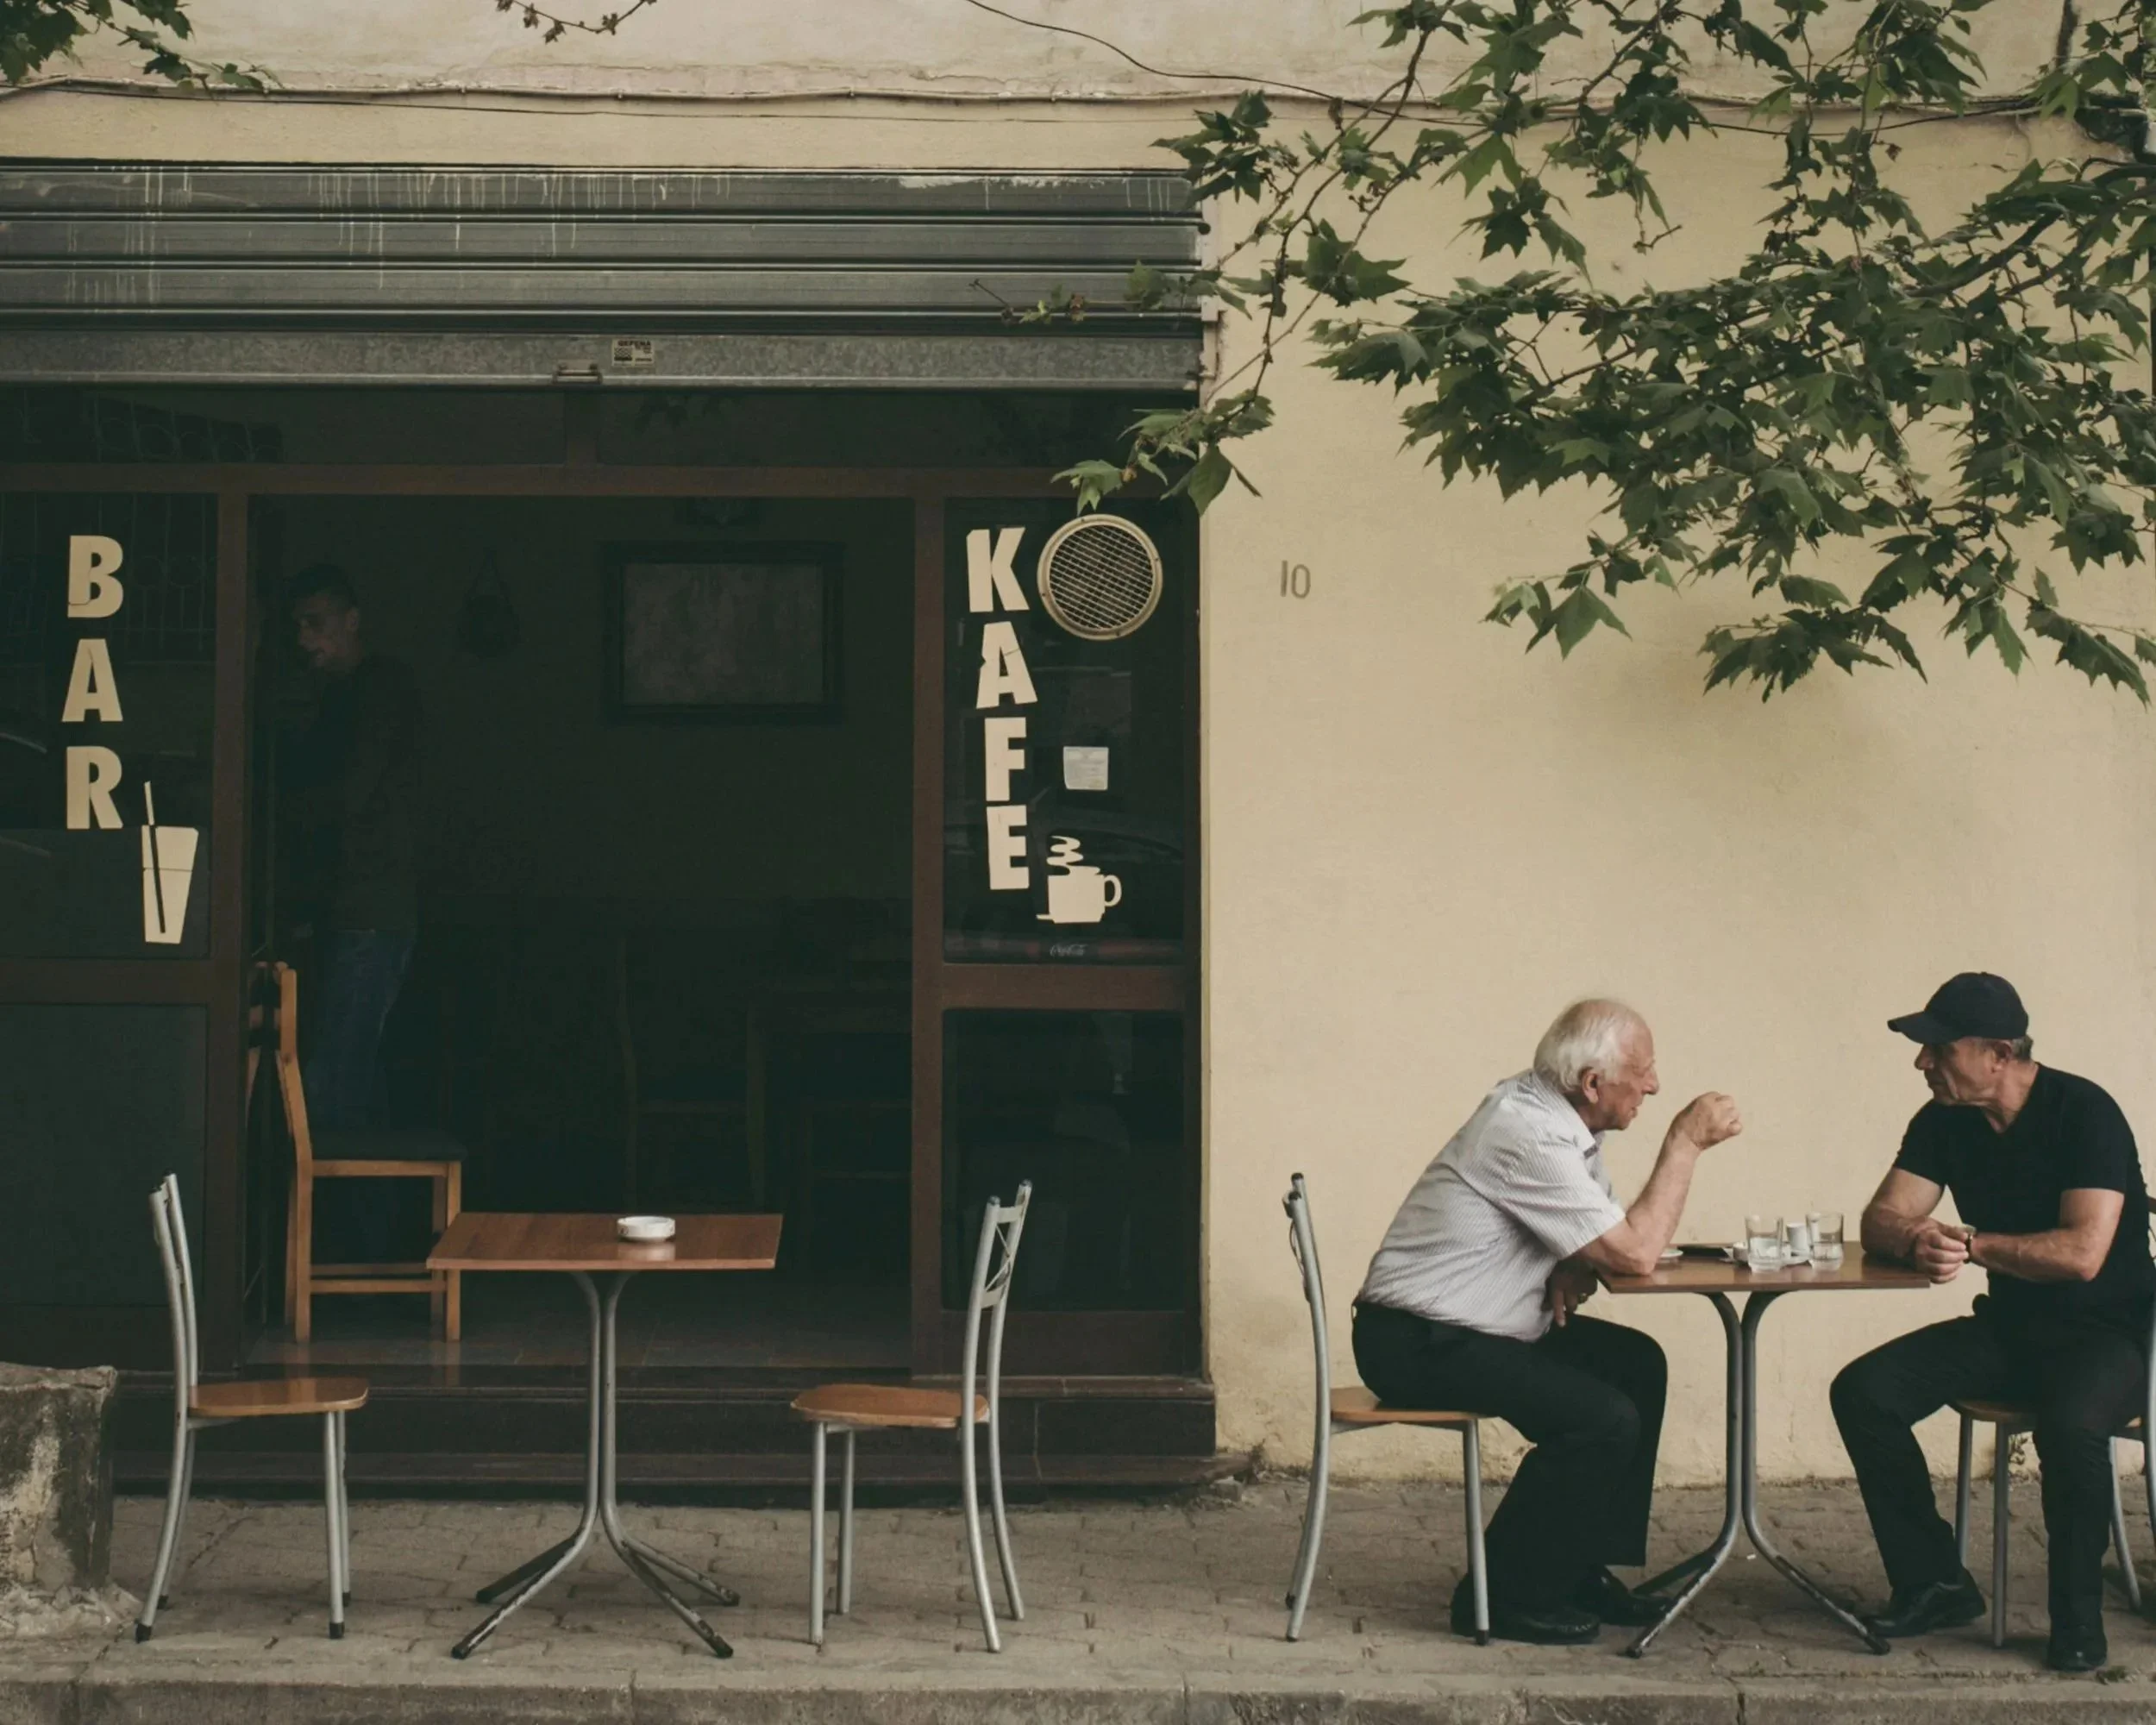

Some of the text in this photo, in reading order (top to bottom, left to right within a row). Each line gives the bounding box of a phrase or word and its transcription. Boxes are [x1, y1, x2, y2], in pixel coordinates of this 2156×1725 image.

[61, 535, 123, 830] BAR
[967, 527, 1038, 890] KAFE
[1280, 560, 1311, 599] 10
